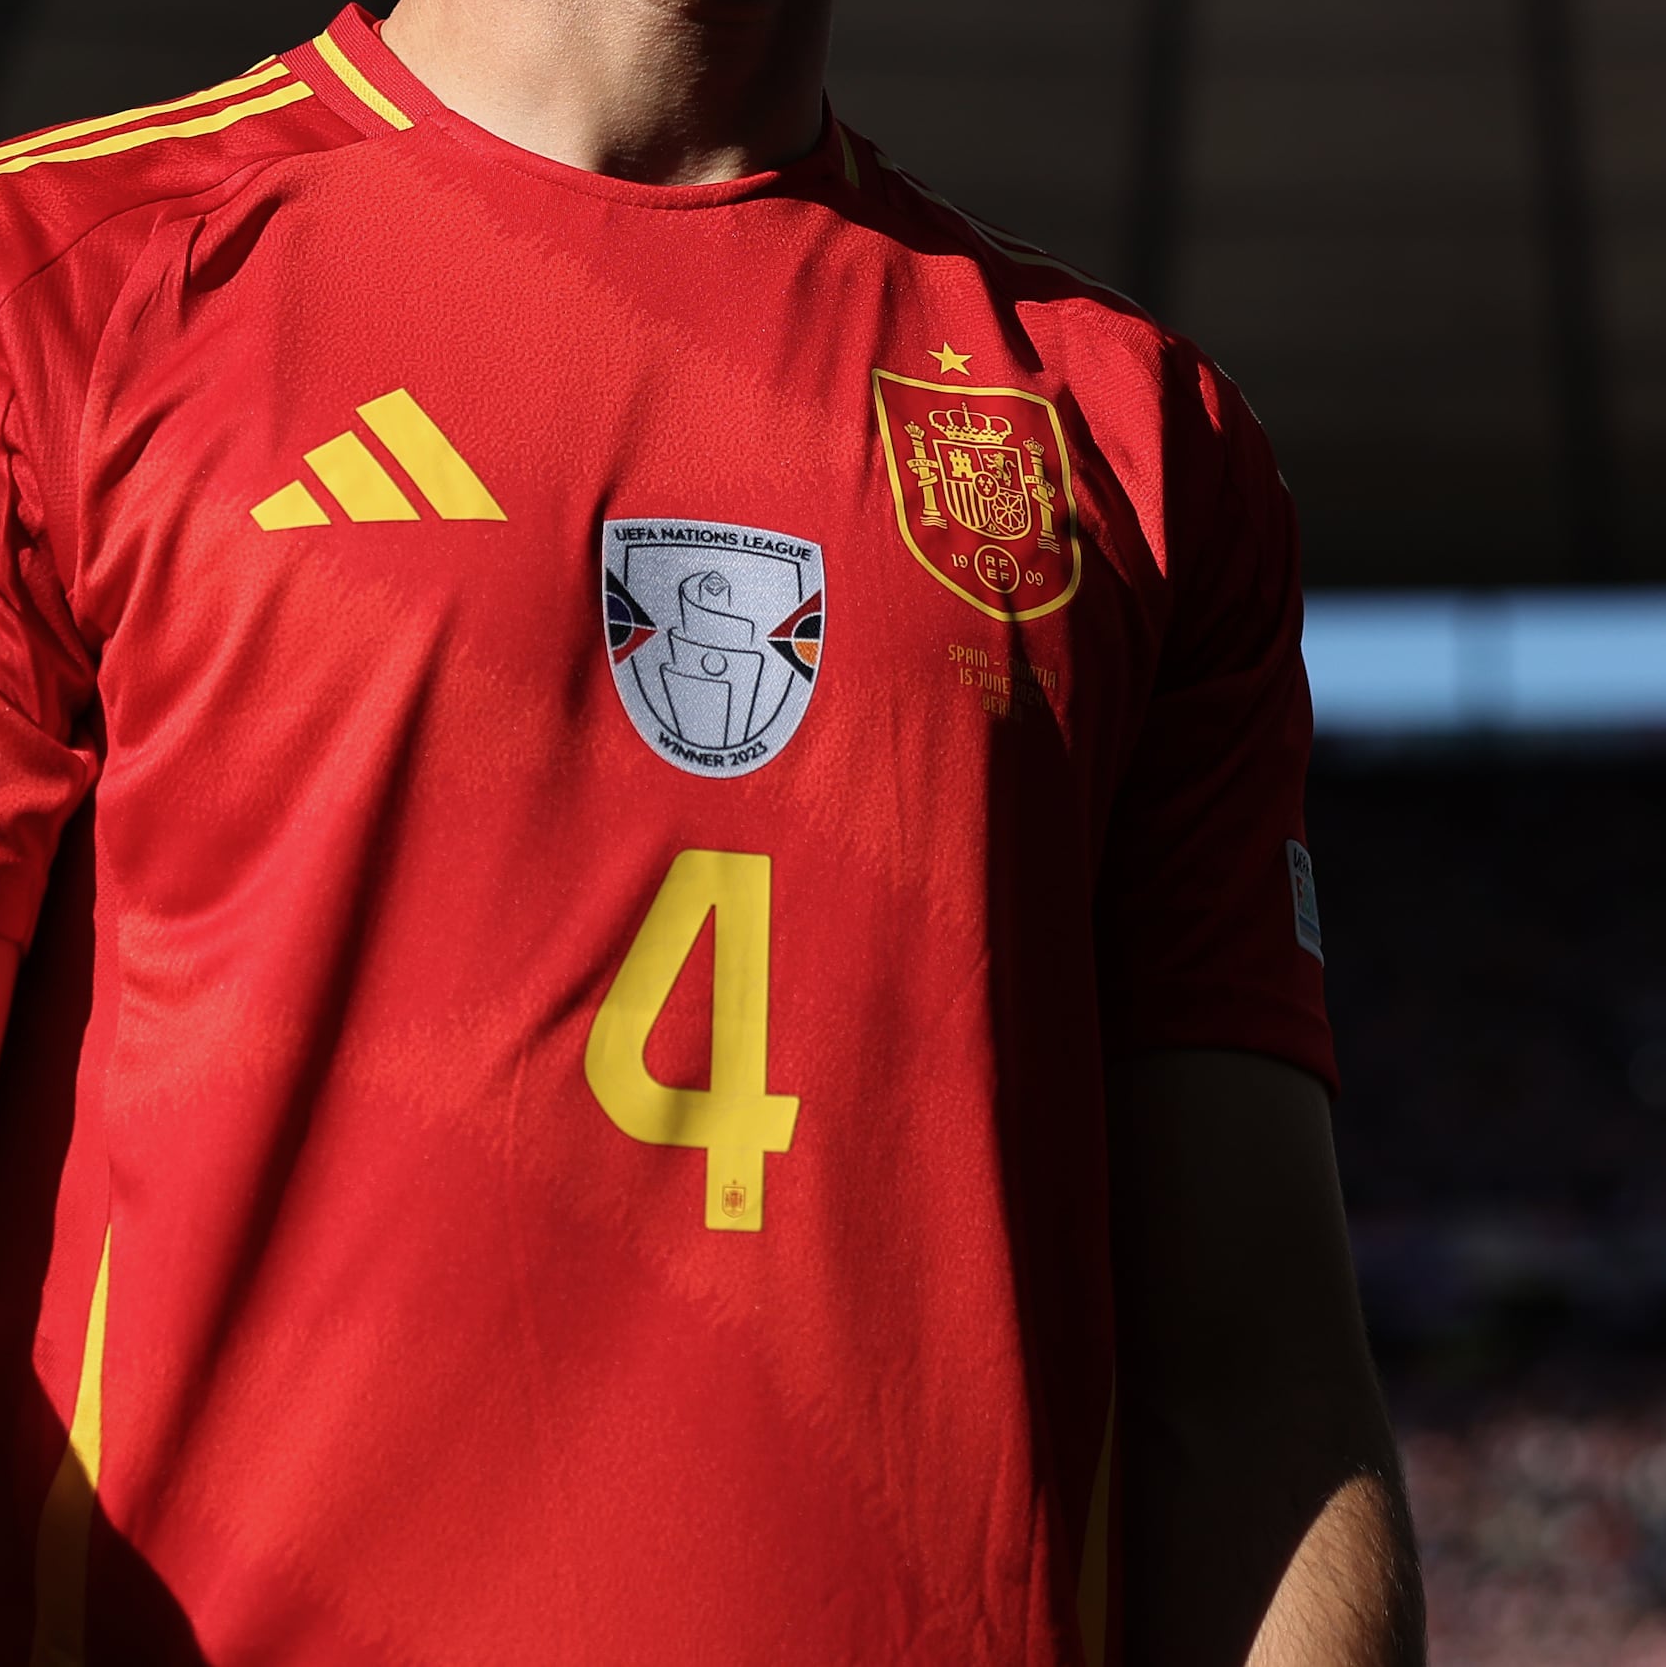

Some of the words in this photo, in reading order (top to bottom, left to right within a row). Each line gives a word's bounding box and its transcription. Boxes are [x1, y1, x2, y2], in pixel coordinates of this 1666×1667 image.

[615, 528, 657, 541] UEFA
[661, 528, 738, 545] NATIONS
[743, 535, 811, 561] LEAGUE
[951, 553, 968, 569] 19
[1025, 569, 1044, 586] 09
[948, 644, 988, 668] SPAIN
[1007, 658, 1057, 690] CROATIA
[959, 667, 973, 686] 15
[977, 671, 1011, 695] JUNE
[982, 693, 1023, 722] BERL
[659, 732, 724, 767] WINNER
[729, 741, 768, 766] 2023
[584, 848, 800, 1232] 4
